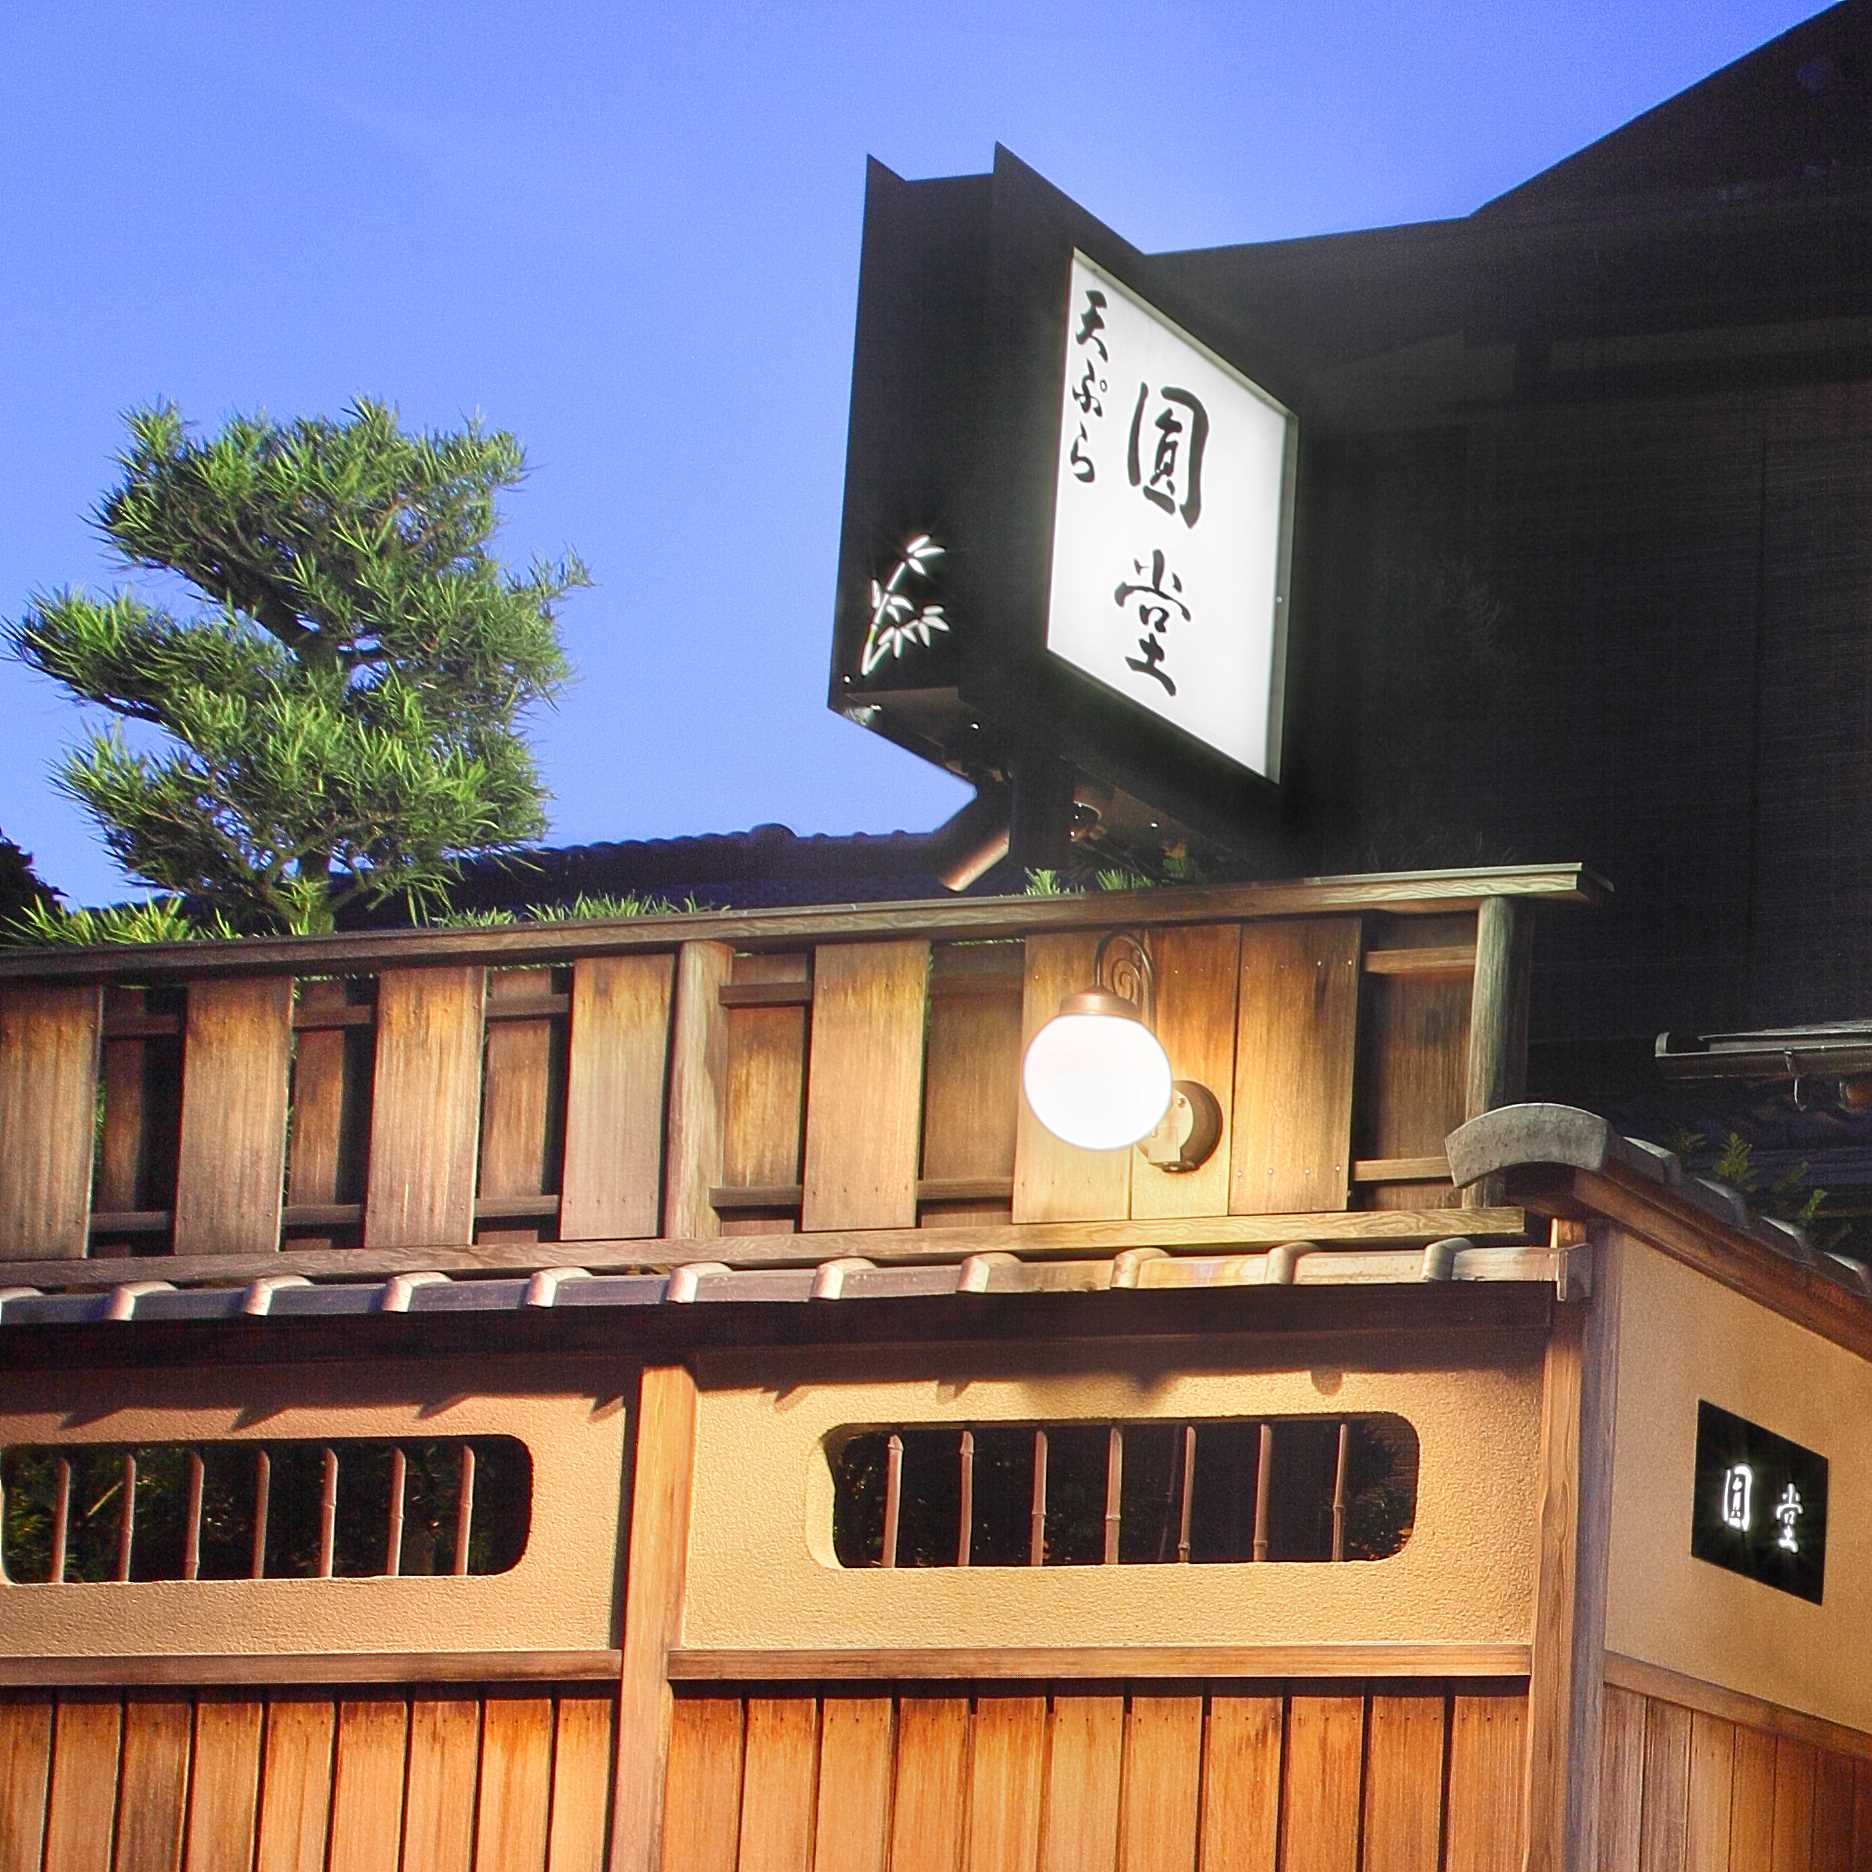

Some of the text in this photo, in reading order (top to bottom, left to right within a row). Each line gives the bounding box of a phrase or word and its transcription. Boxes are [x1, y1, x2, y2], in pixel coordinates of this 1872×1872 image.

[1066, 289, 1109, 484] 天ぷら
[1113, 381, 1211, 697] 圓堂
